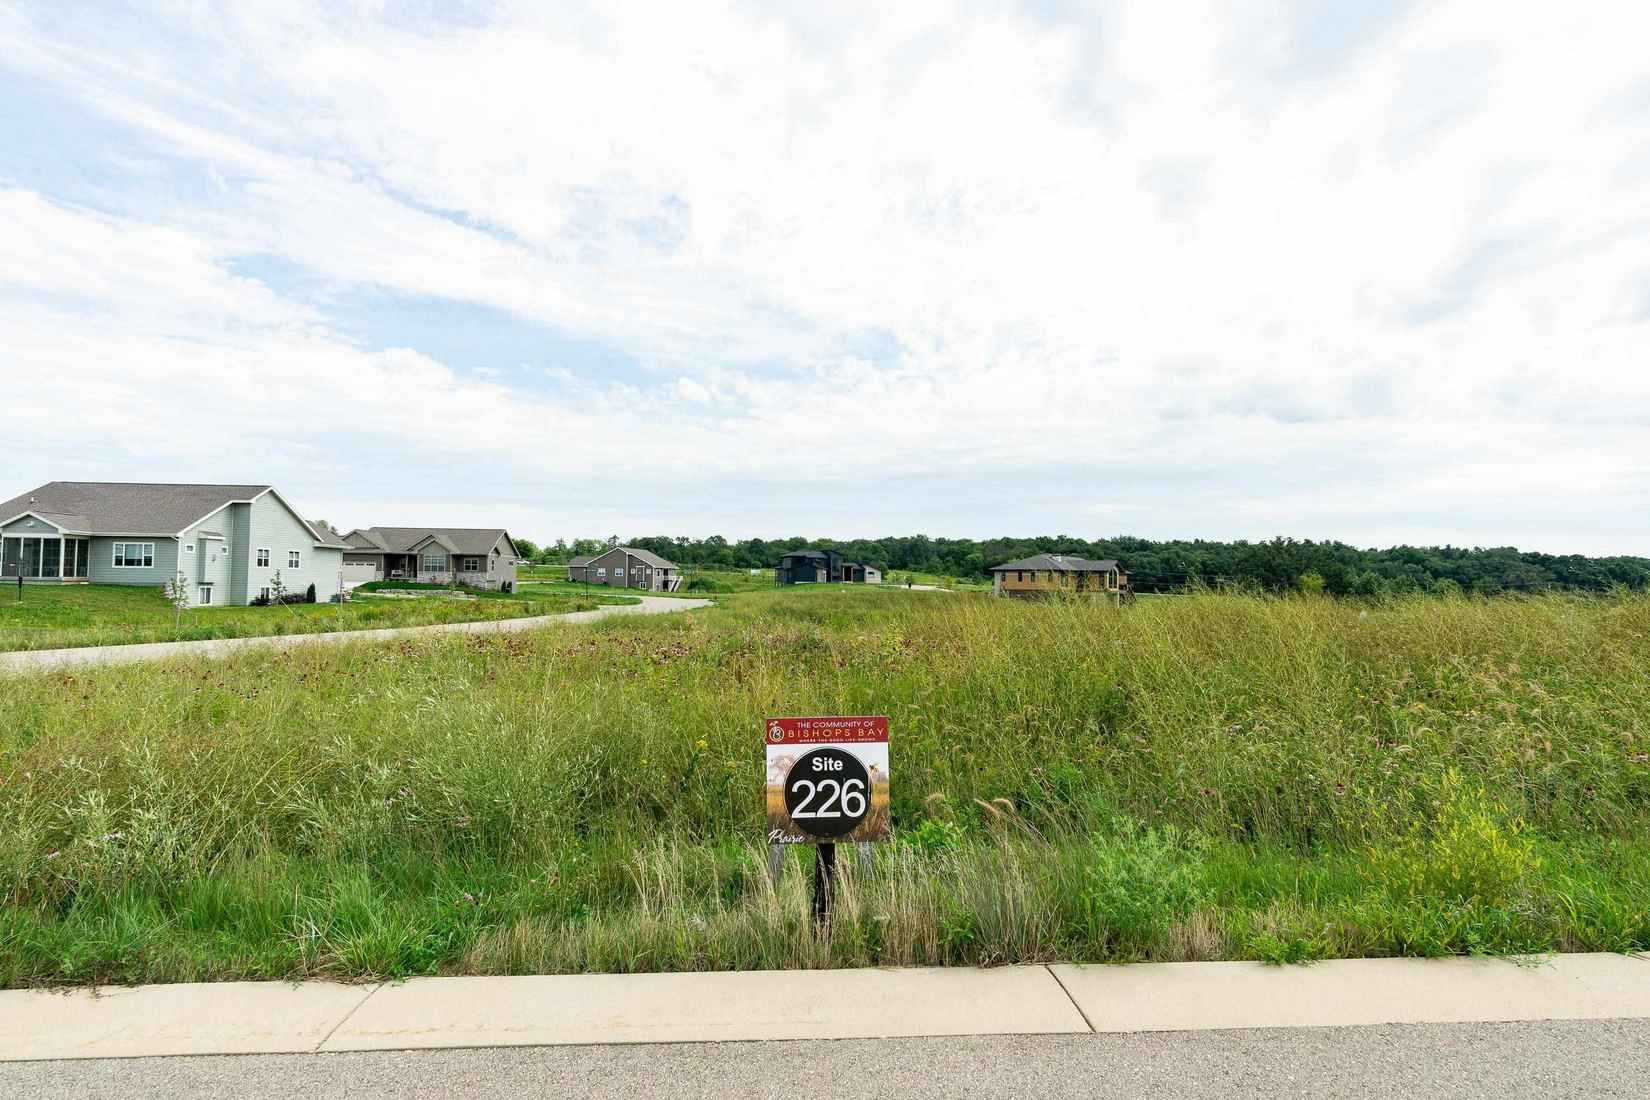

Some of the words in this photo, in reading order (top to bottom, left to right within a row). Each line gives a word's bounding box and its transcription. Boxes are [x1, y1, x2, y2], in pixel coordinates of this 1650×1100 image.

[813, 720, 861, 728] COMMUNITY
[788, 729, 851, 738] BISHOPS
[858, 728, 884, 737] BAY
[812, 757, 843, 771] Site
[791, 778, 866, 819] 226
